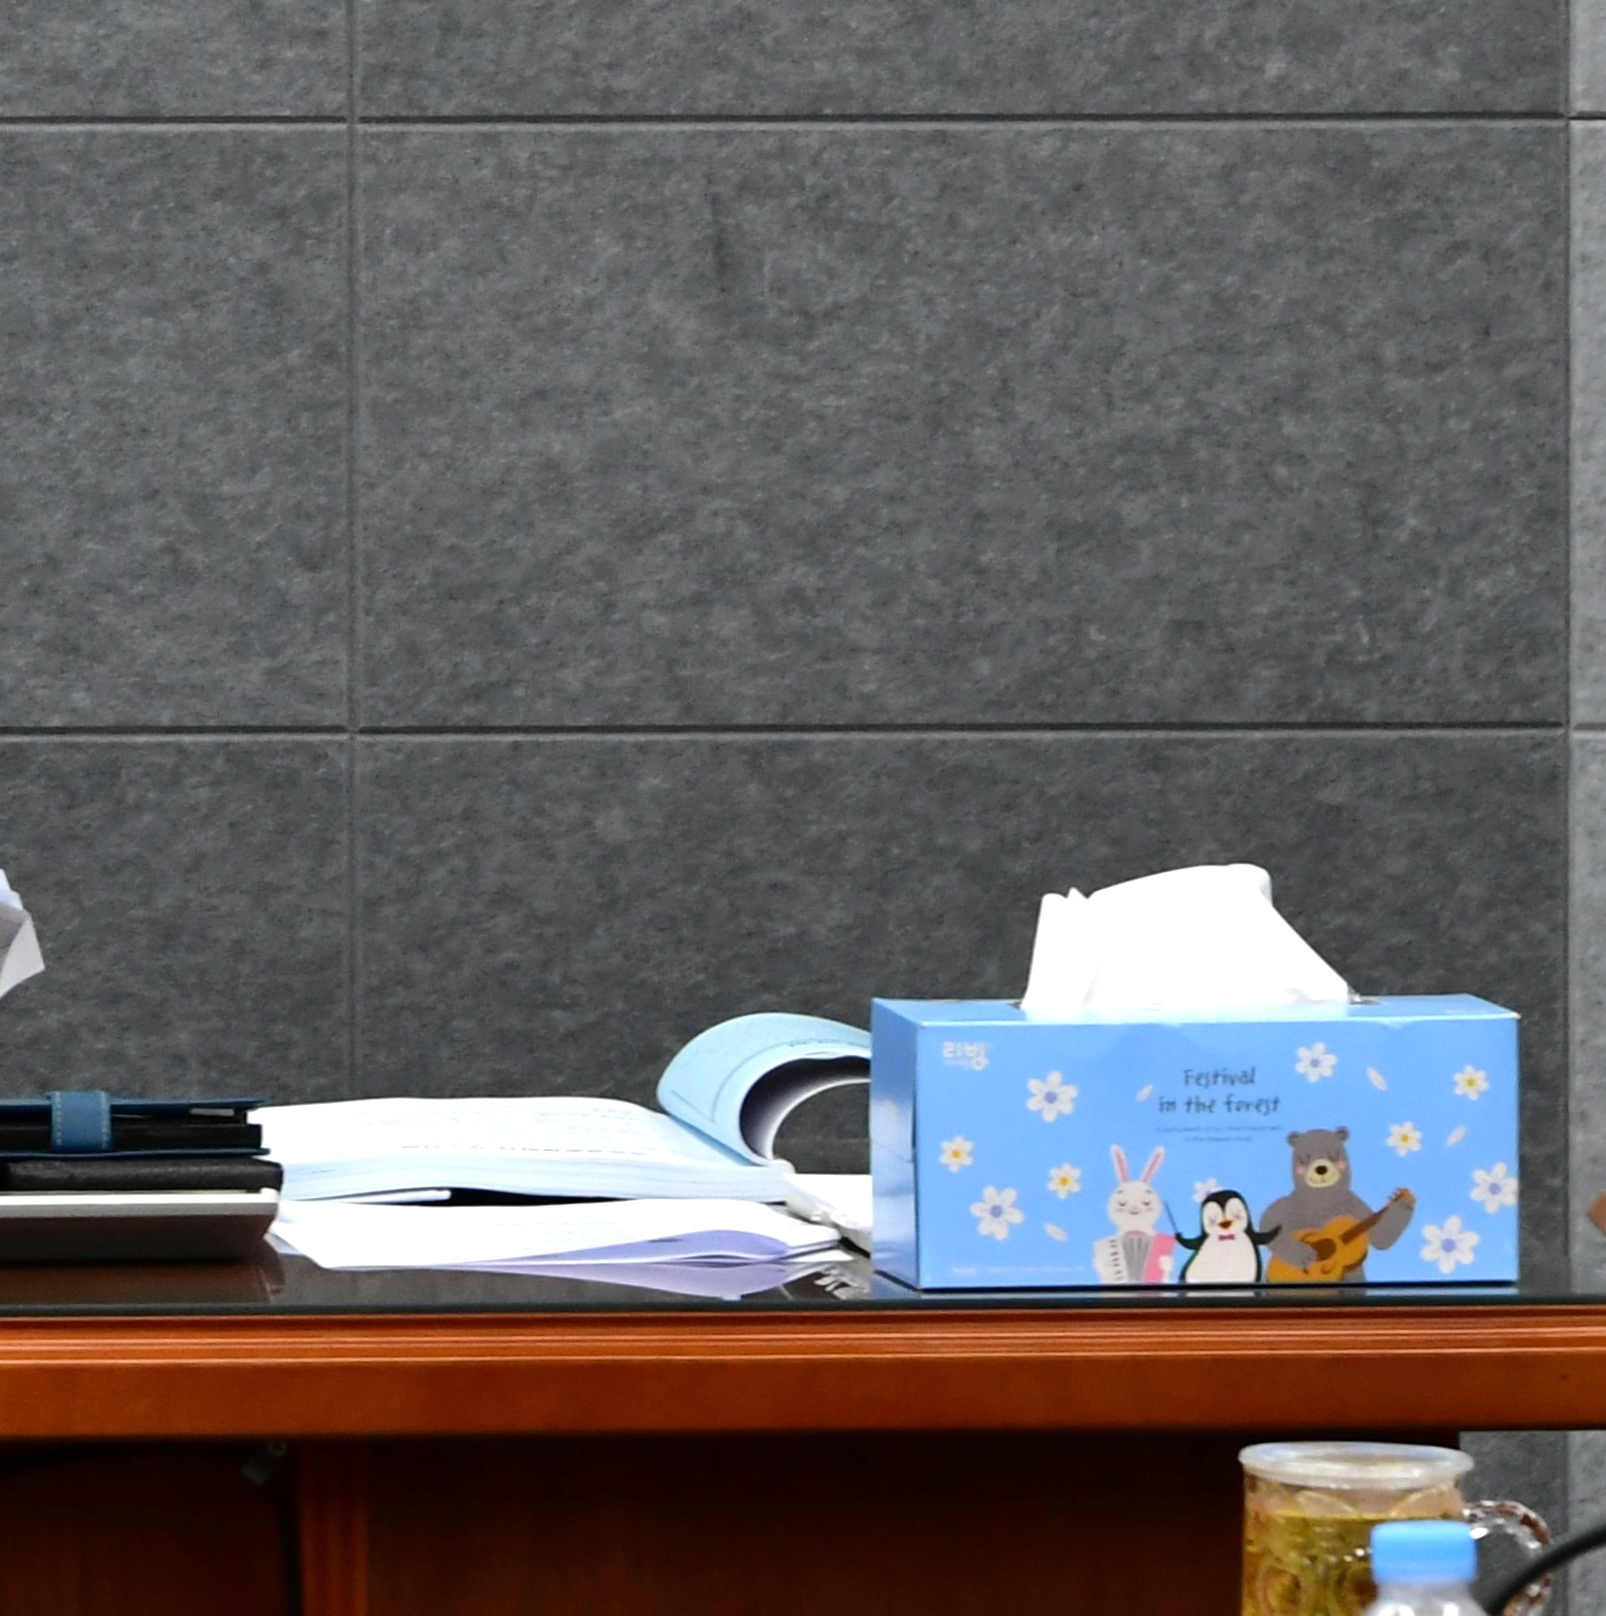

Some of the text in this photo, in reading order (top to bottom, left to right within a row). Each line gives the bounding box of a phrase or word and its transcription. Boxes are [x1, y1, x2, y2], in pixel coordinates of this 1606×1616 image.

[1183, 1066, 1256, 1089] Festival
[1158, 1093, 1280, 1116] in the forest
